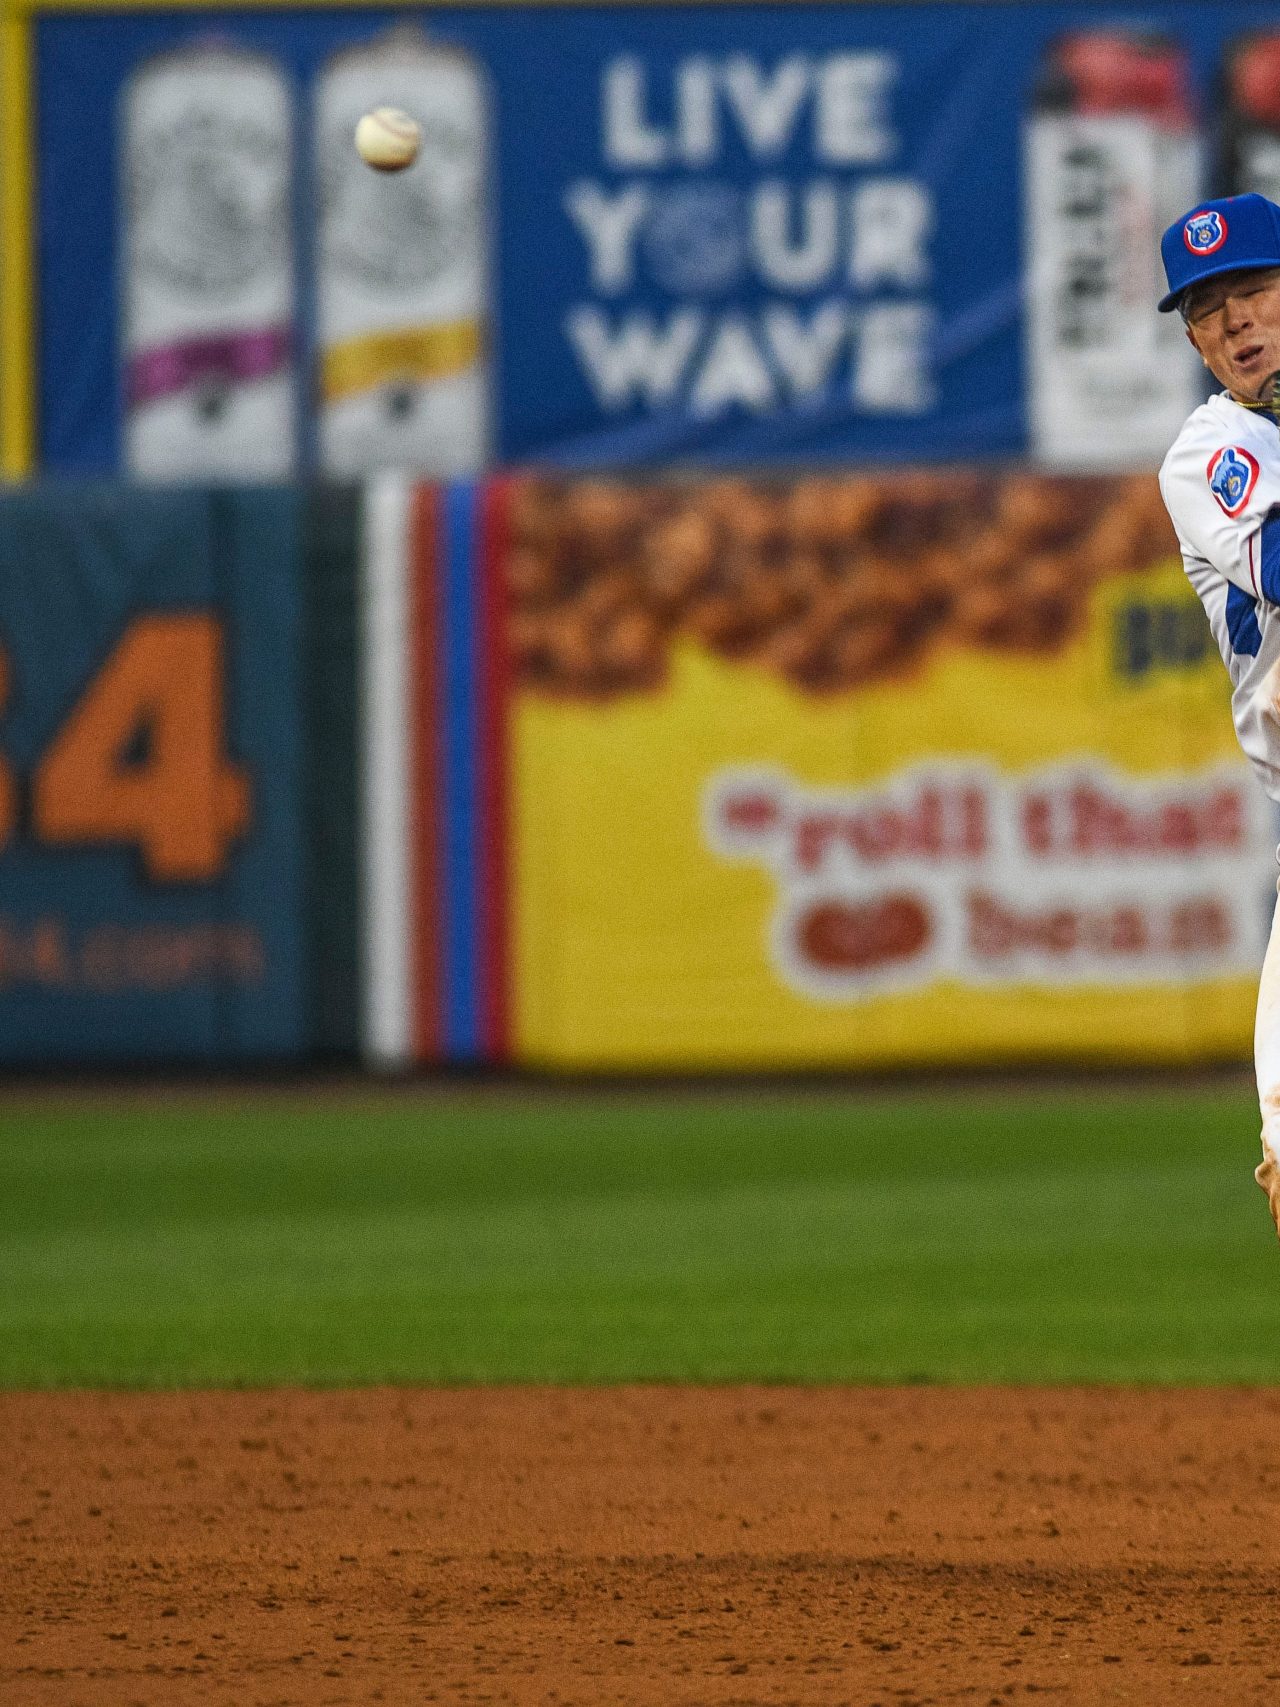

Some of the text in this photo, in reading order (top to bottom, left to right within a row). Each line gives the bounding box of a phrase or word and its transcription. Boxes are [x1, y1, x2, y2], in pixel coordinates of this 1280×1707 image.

[604, 52, 898, 166] LIVE
[567, 180, 934, 296] YOUR
[566, 304, 936, 412] WAVE
[1021, 775, 1244, 853] that
